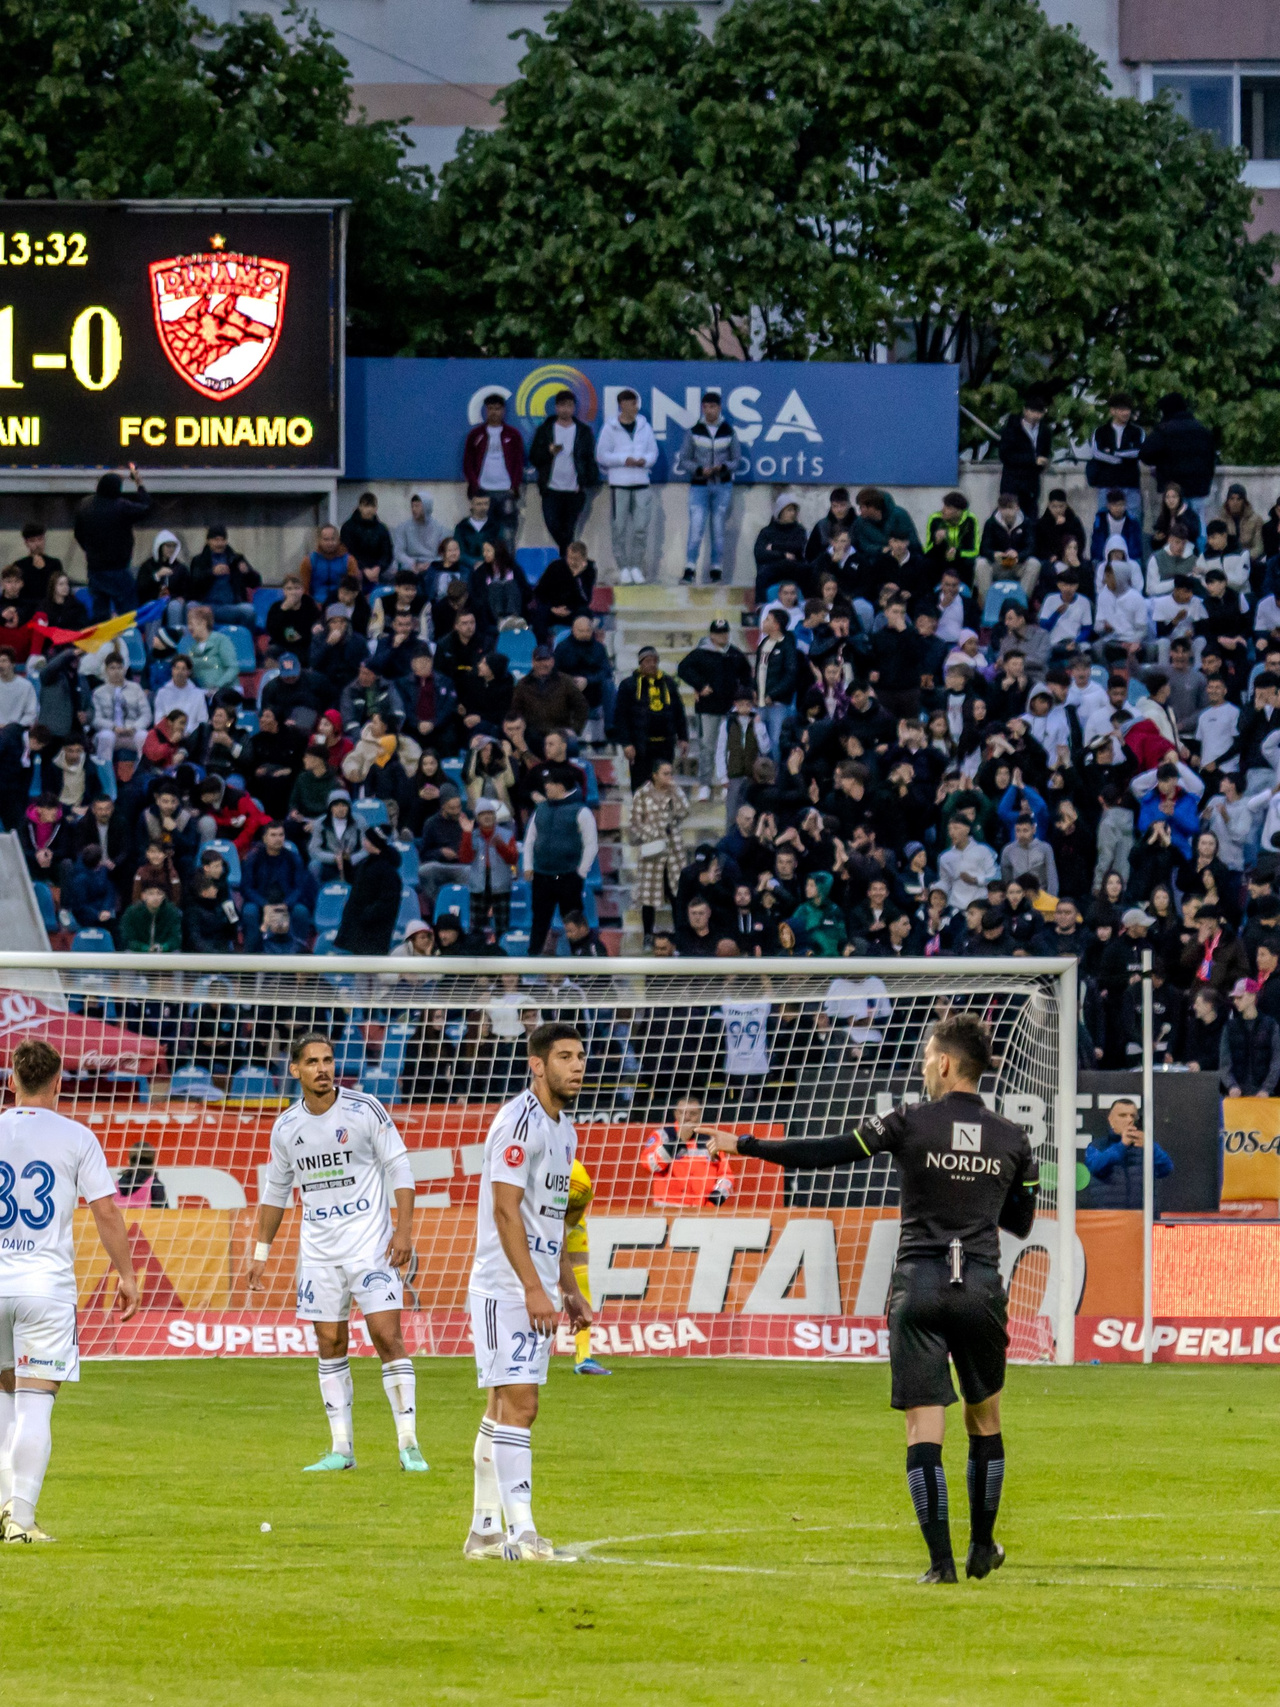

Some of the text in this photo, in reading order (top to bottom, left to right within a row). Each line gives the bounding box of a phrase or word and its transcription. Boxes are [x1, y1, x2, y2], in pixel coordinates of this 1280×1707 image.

[161, 262, 279, 294] DINAMO
[121, 417, 314, 447] FC DINAMO
[297, 1150, 353, 1171] UNIBET
[926, 1152, 1001, 1175] NORDIS
[2, 1238, 35, 1251] DAVID
[511, 1331, 538, 1362] 27
[29, 1357, 53, 1366] Smart
